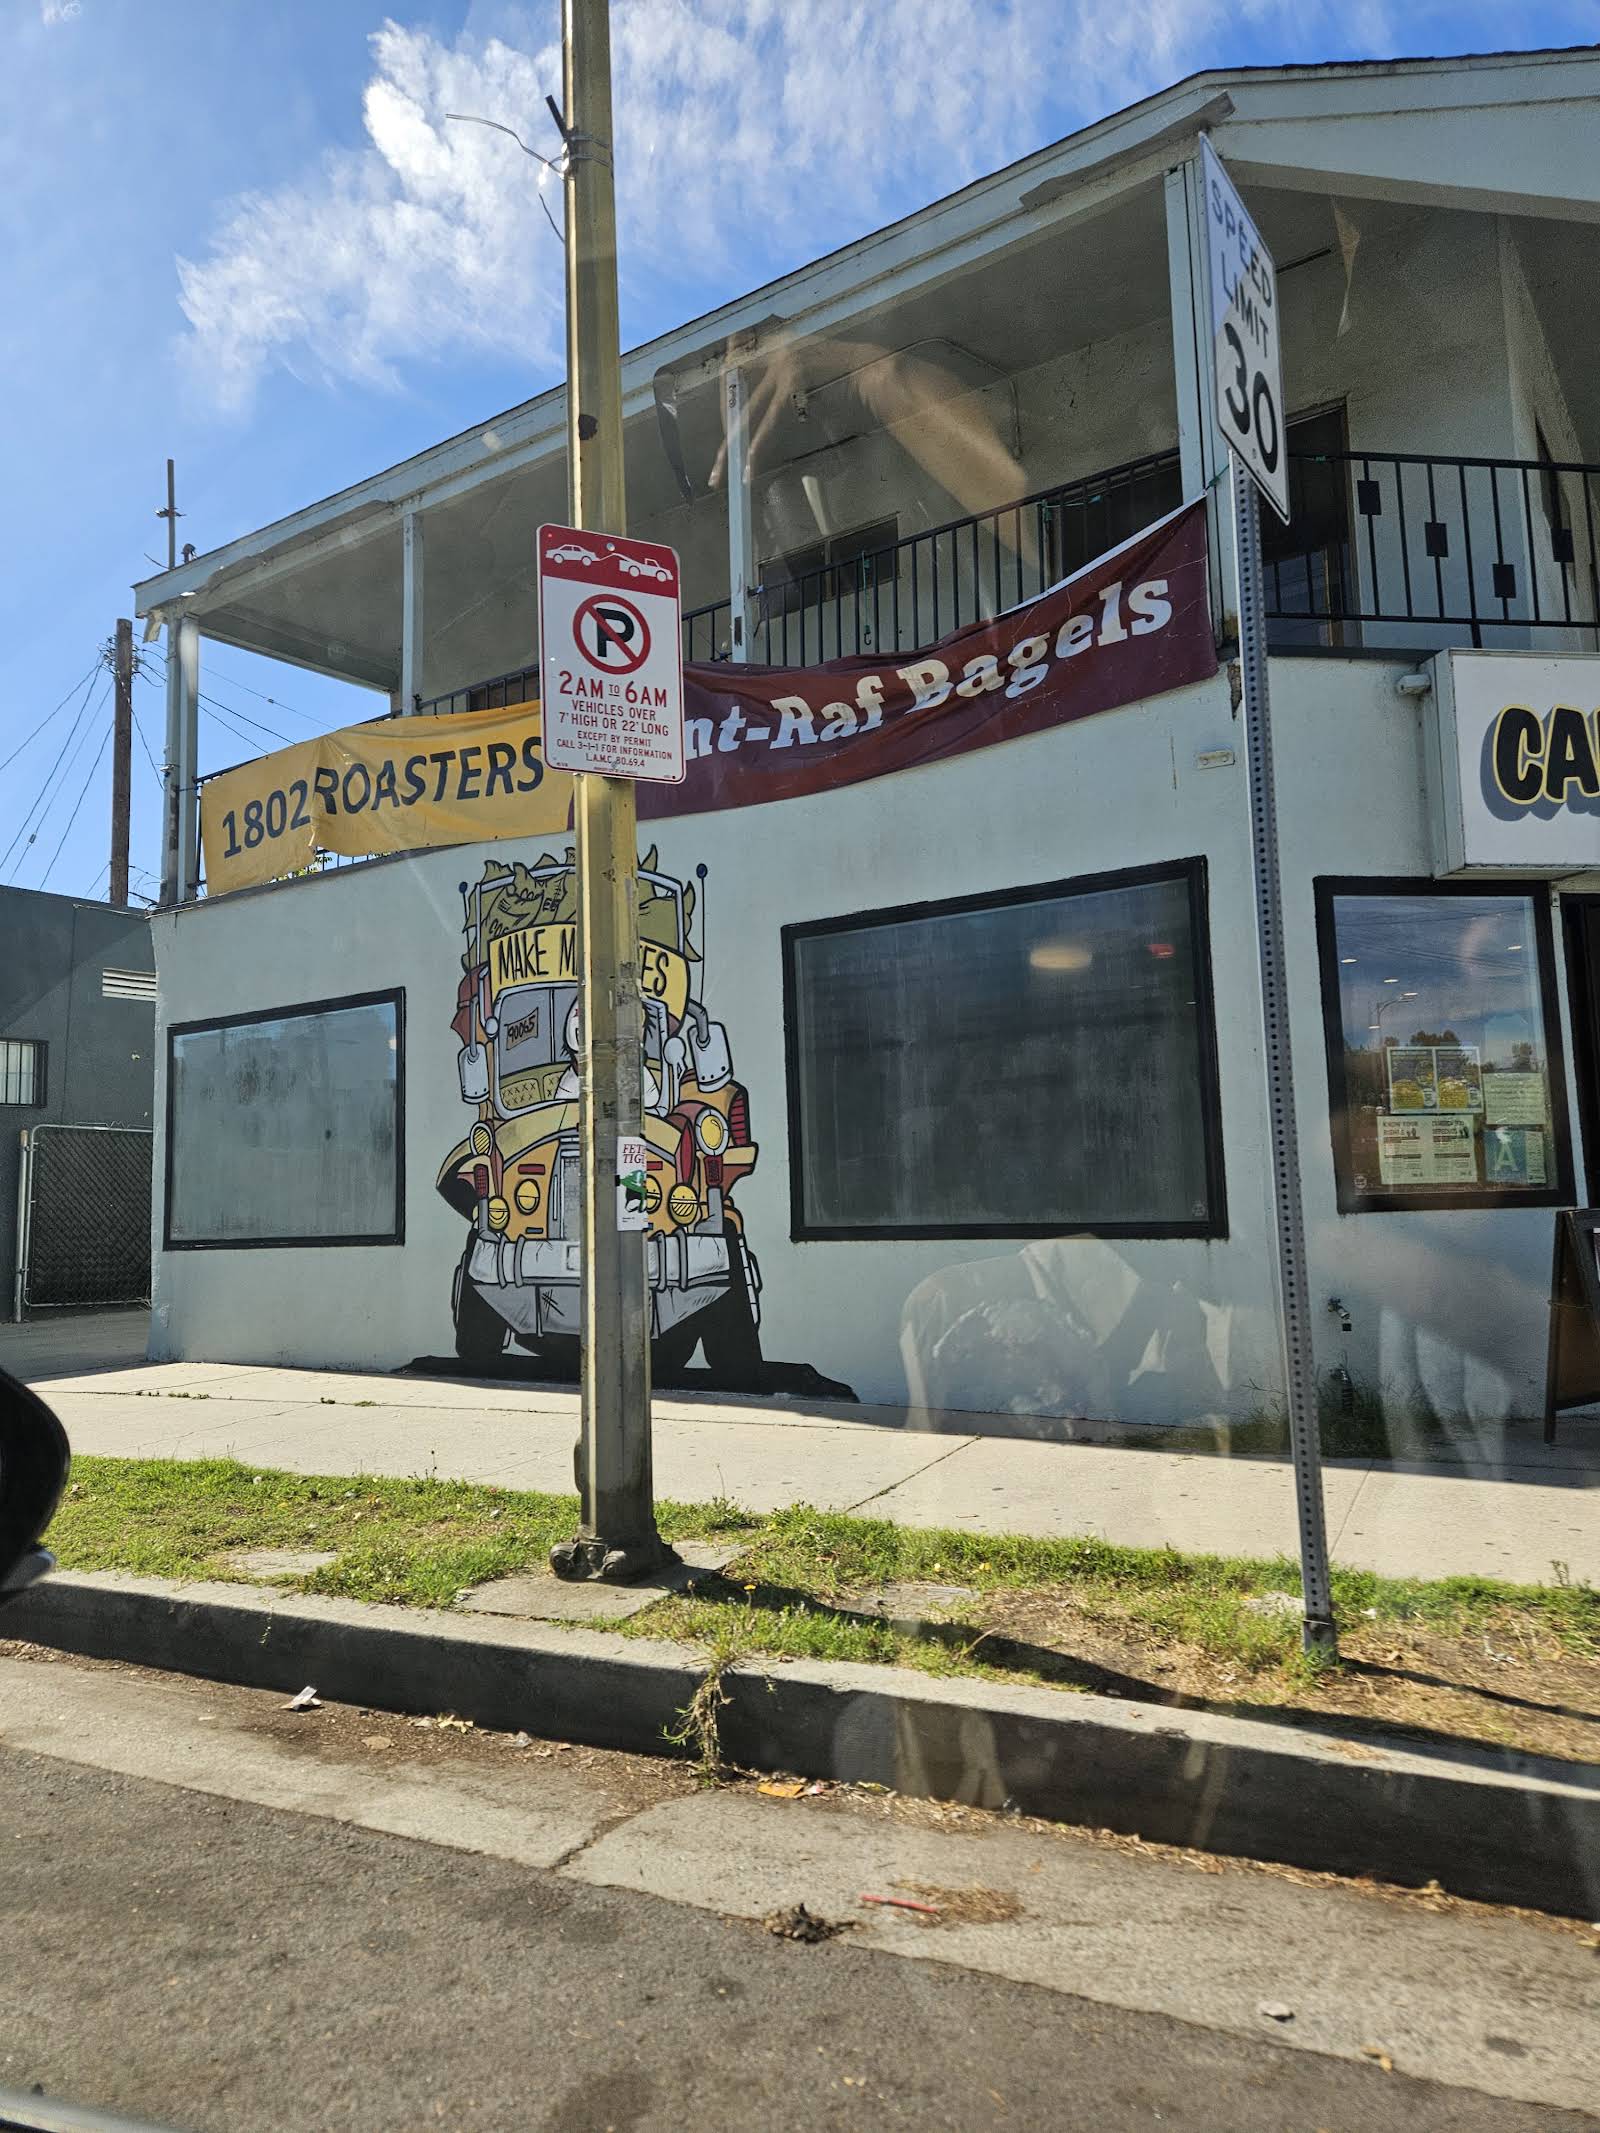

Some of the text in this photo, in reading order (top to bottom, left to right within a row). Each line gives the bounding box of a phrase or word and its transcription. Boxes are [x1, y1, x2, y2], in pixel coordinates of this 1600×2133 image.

[1211, 178, 1272, 309] SPEED
[1222, 251, 1269, 359] LIMIT
[1224, 322, 1279, 474] 30
[898, 579, 1174, 714] Bagels
[559, 671, 668, 708] 2AM TO 6AM
[572, 699, 656, 721] VEHICLES OVER
[556, 738, 672, 760] CALL 3-1-1 FOR INFORMATION
[571, 713, 598, 728] HIGH
[602, 717, 617, 730] OR
[641, 722, 669, 737] LONG
[577, 730, 651, 748] EXCEPT BY PERMIT
[222, 736, 543, 859] 1802 ROASTERS
[499, 928, 549, 985] MAKE
